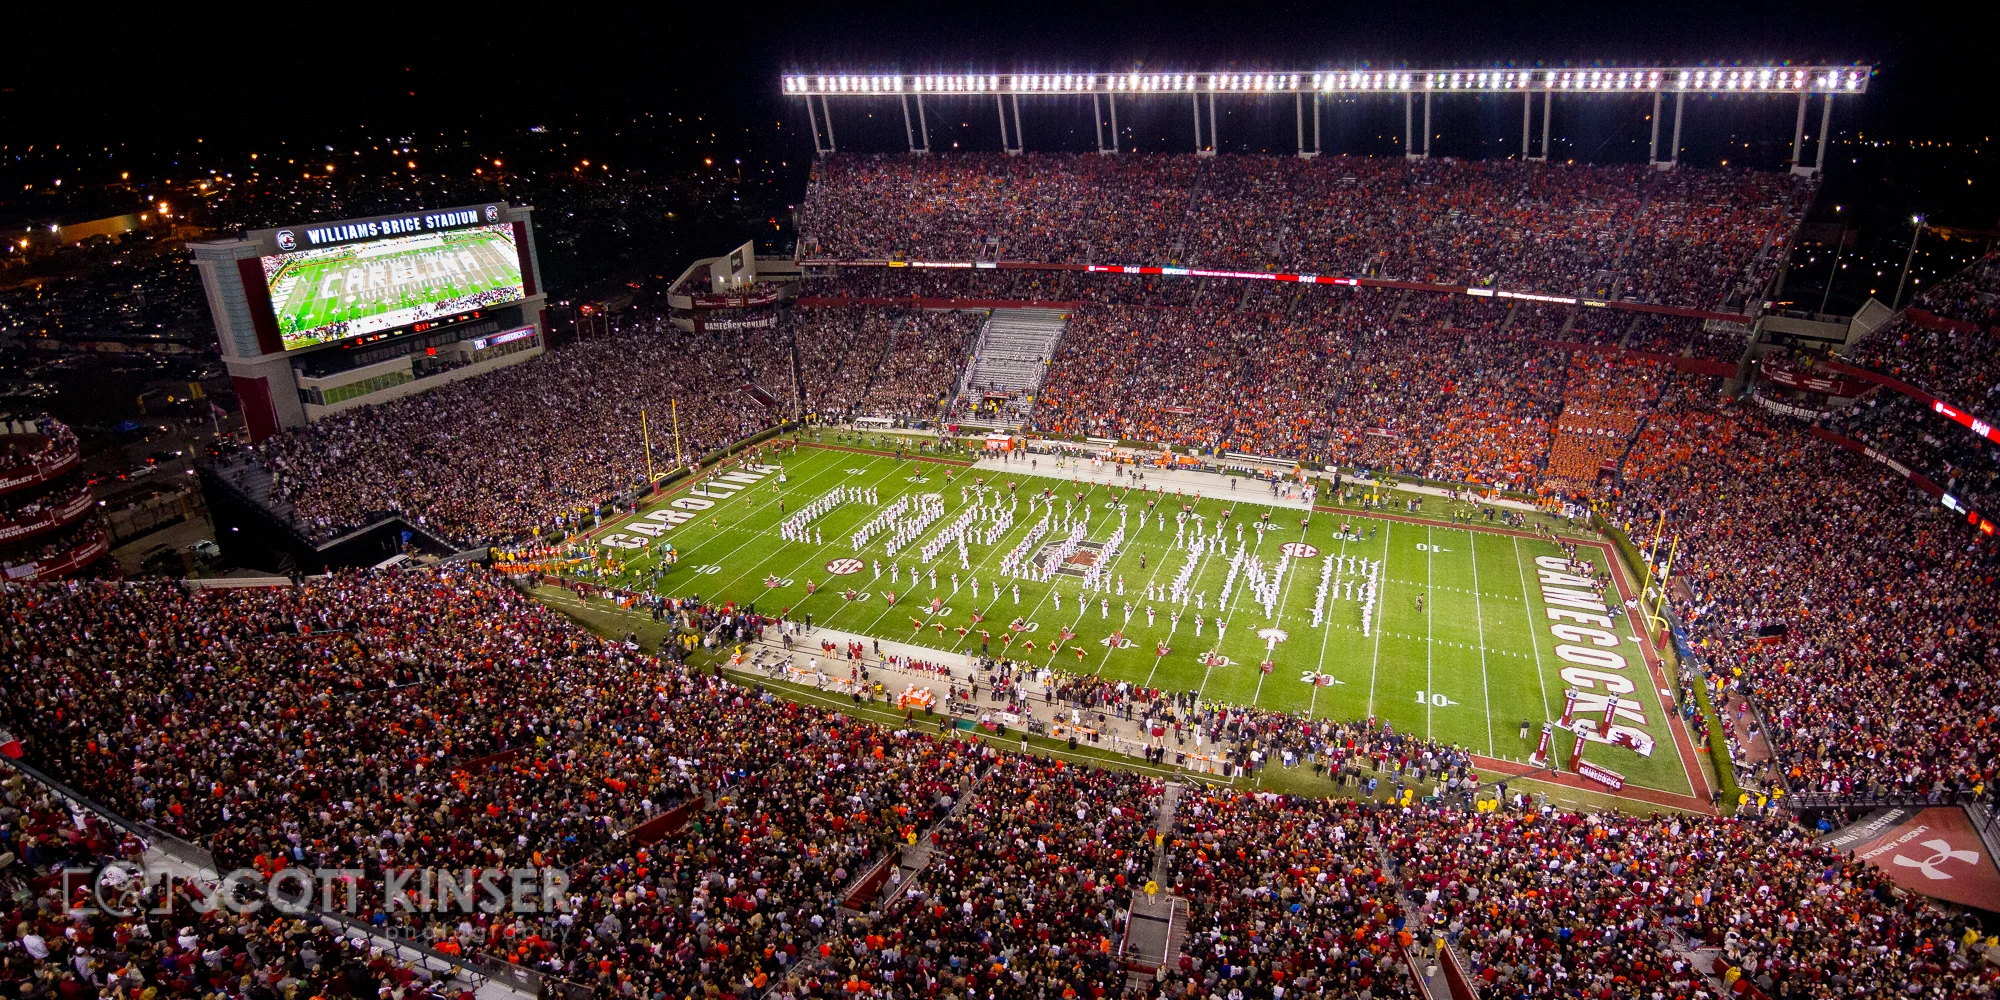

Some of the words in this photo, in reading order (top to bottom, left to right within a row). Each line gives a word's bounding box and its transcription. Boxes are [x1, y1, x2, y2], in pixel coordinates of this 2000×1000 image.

[307, 217, 421, 245] WILLIAMS-BRICE
[426, 210, 479, 229] STADIUM
[1765, 399, 1819, 419] WILLIAMS-BRICE
[600, 463, 784, 550] CAROLINA
[1281, 542, 1318, 557] SEC
[700, 564, 722, 575] 10
[826, 560, 865, 574] SEC
[1534, 555, 1656, 752] GAMECOCKS
[1414, 690, 1449, 708] 10
[1578, 766, 1621, 789] GAMECOCKS
[1897, 825, 1930, 843] UNDER
[1860, 841, 1898, 860] ARMOUR
